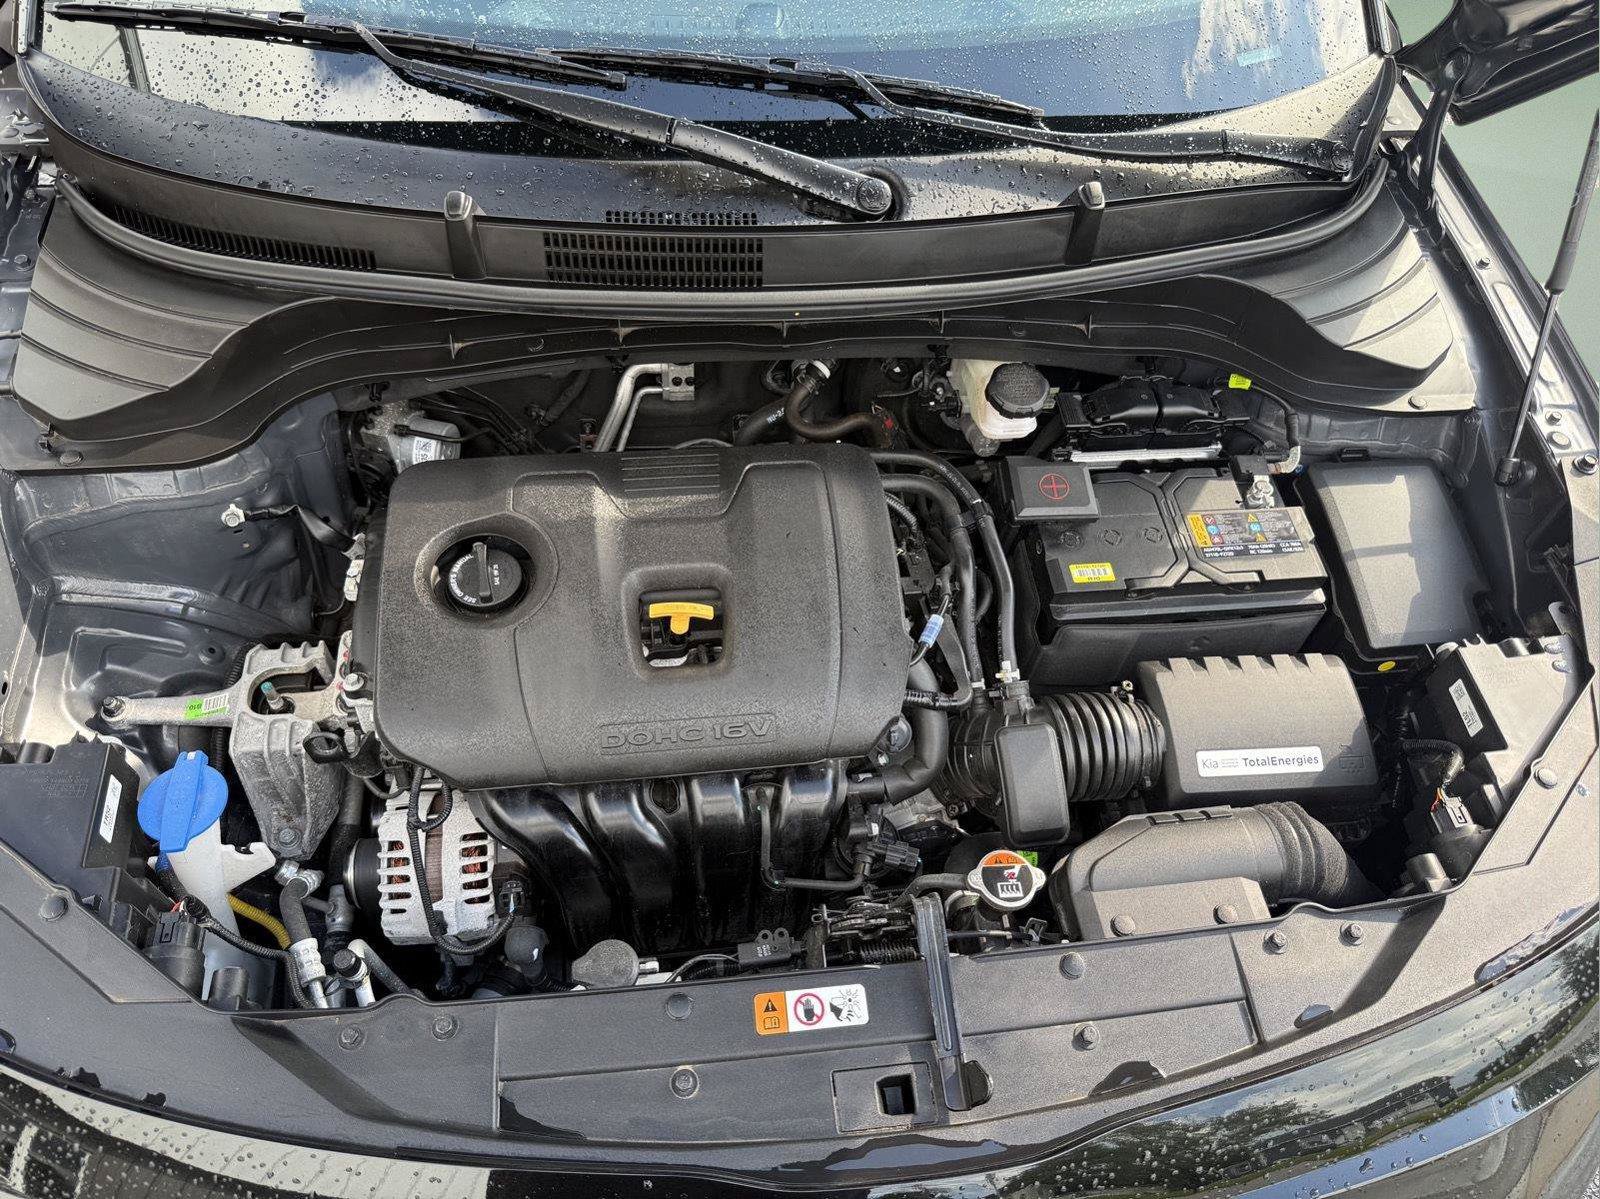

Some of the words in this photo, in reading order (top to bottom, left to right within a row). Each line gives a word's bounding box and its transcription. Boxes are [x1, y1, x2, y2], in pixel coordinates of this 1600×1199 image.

[452, 553, 475, 573] MANUAL
[601, 727, 704, 749] DOHC
[713, 720, 772, 740] 16V
[1201, 758, 1219, 769] Kia
[1242, 754, 1319, 768] TotalEnergies
